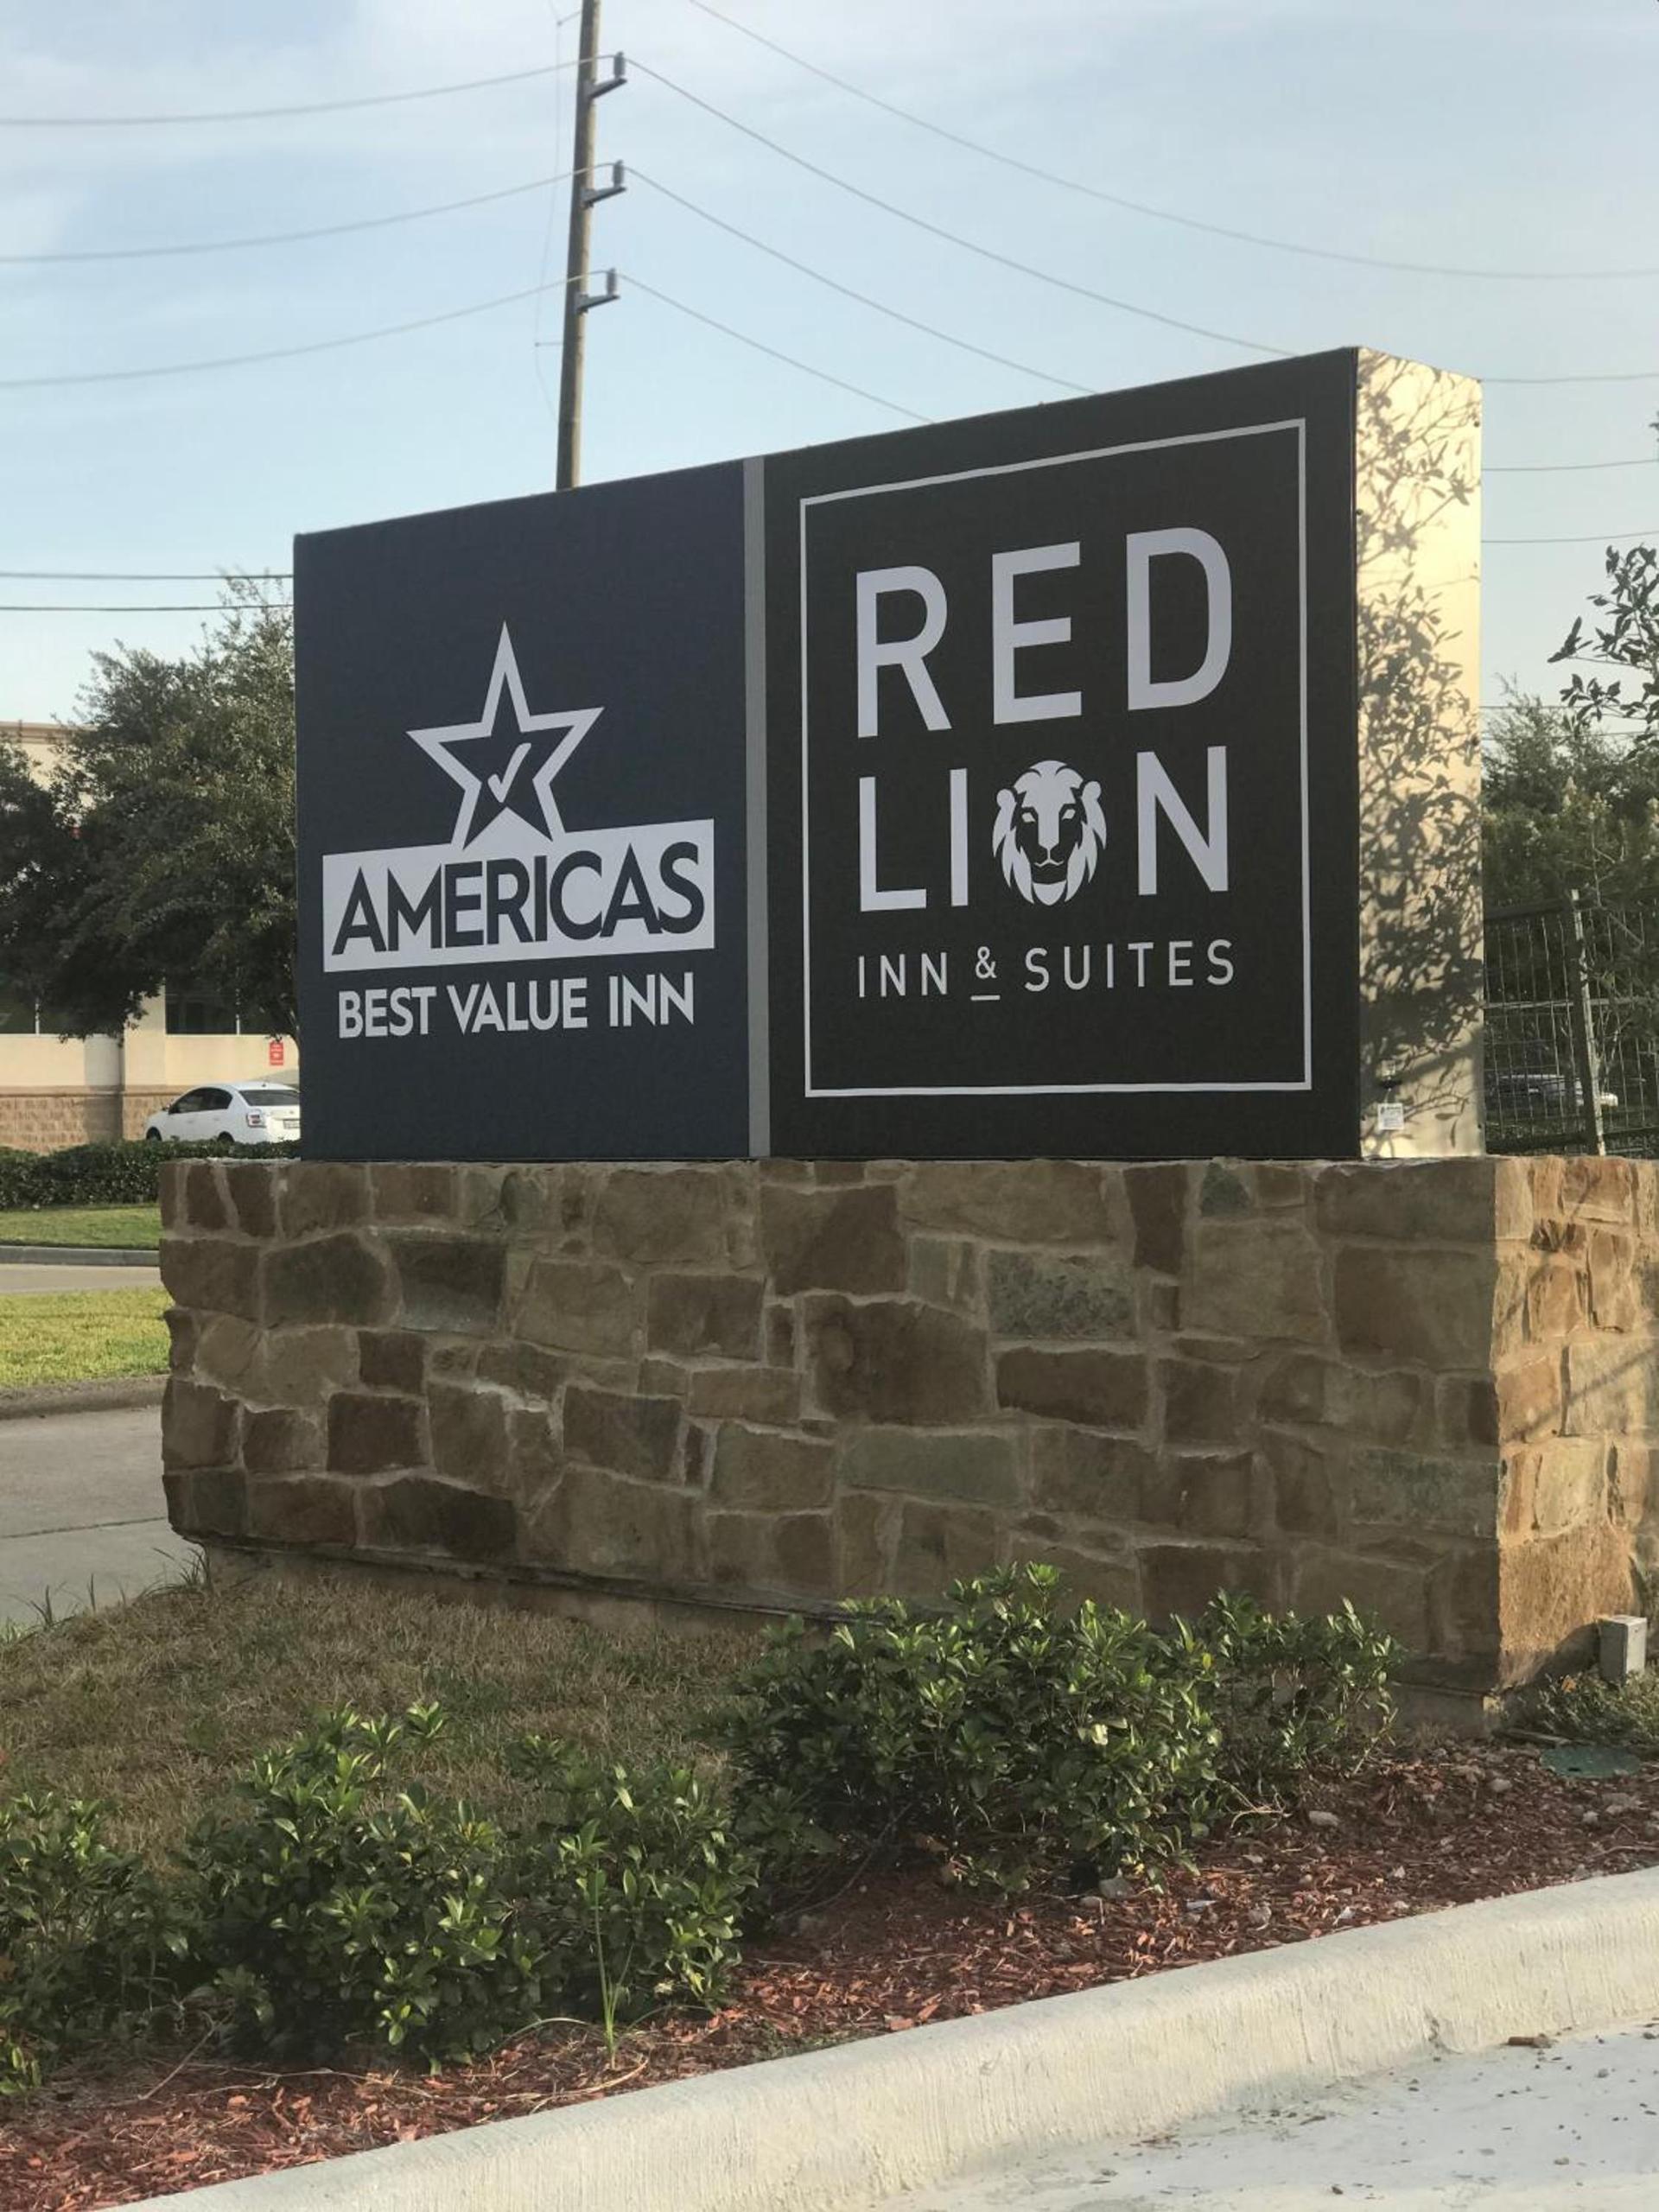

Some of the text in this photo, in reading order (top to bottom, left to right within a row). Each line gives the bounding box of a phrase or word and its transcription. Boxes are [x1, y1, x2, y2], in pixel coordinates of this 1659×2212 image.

[855, 526, 1232, 738] RED
[332, 842, 705, 956] AMERICAS
[338, 972, 695, 1039] BEST VALUE INN
[857, 938, 1235, 999] INN & SUITES
